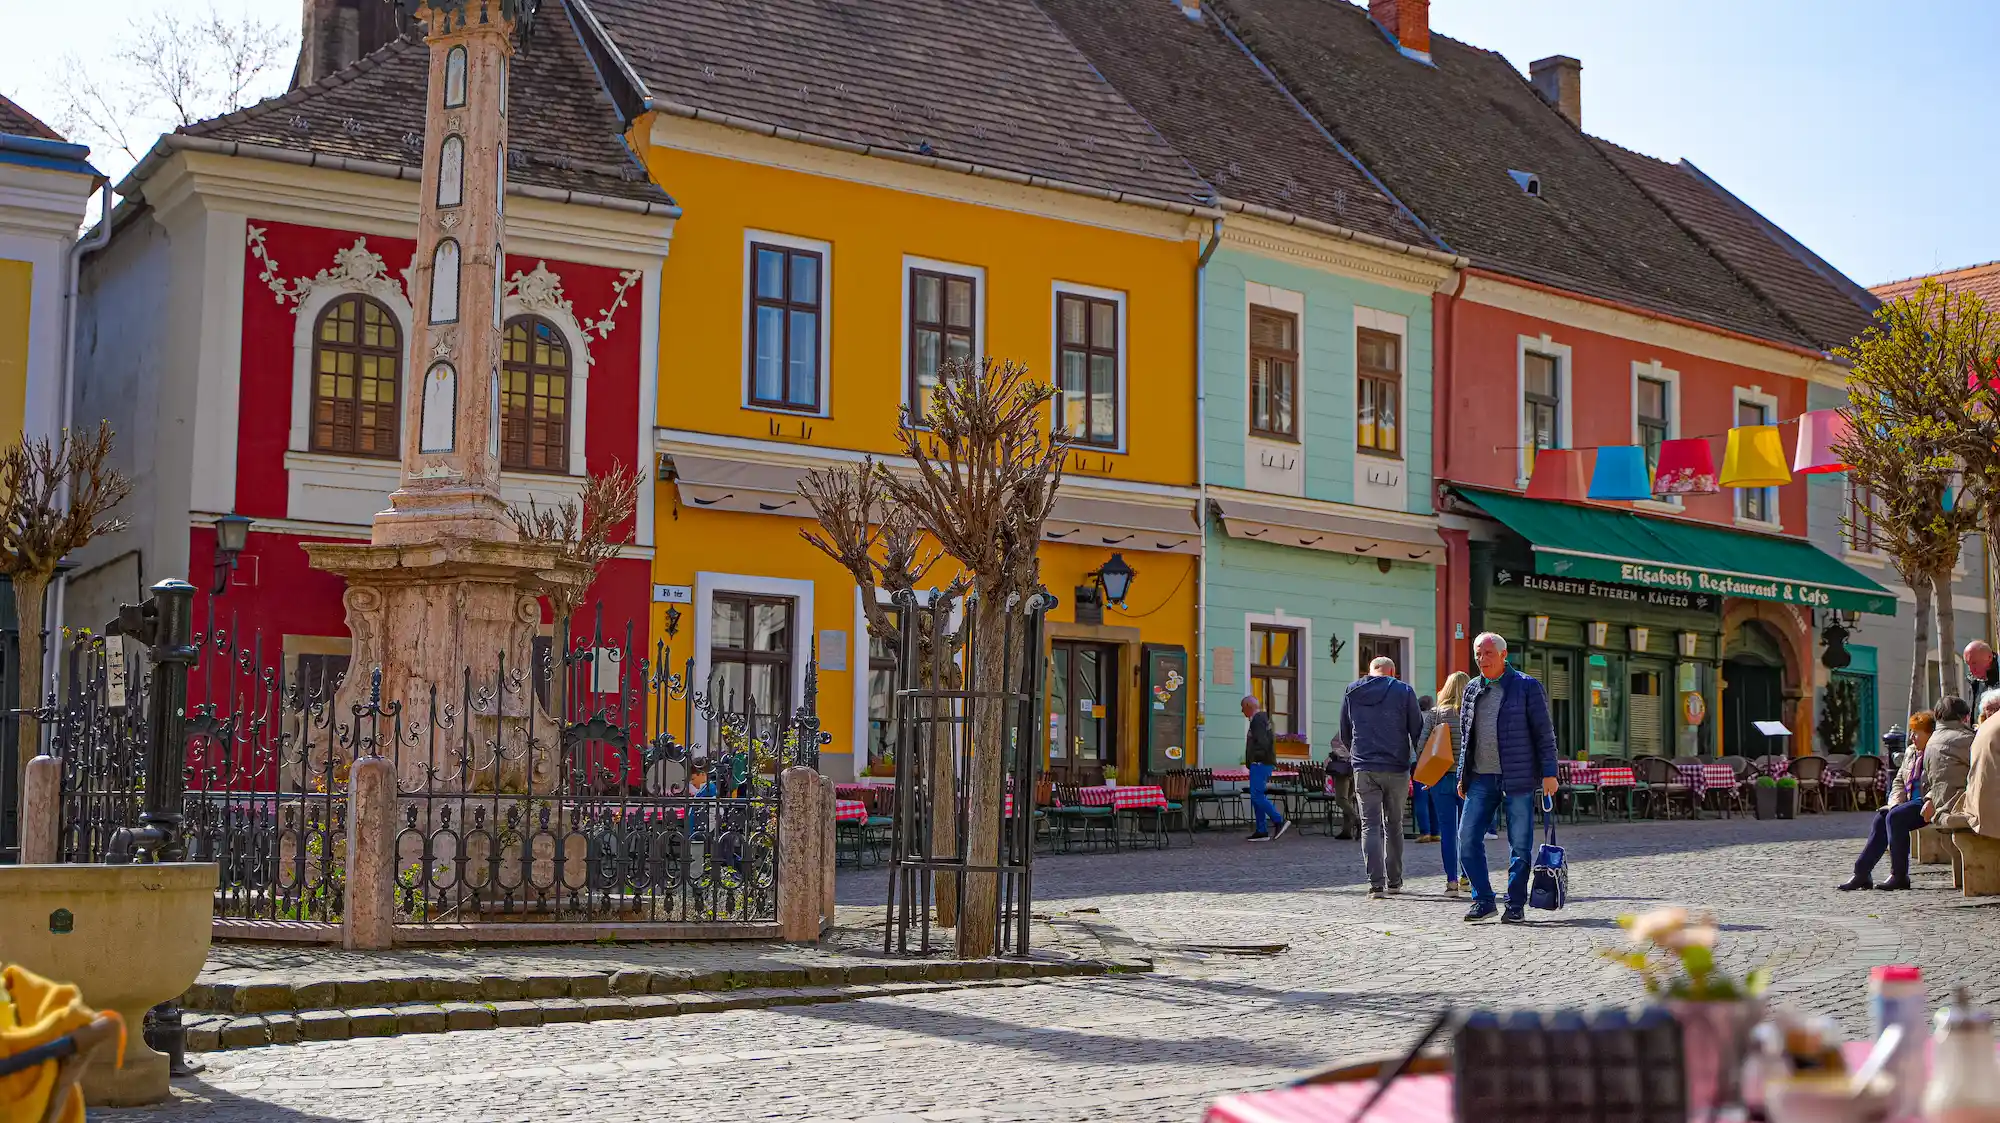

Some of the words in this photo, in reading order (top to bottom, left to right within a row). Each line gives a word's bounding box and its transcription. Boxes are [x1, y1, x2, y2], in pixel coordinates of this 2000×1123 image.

[1523, 575, 1585, 595] ELISABETH
[1589, 582, 1638, 601] ÉTTEREM
[1648, 591, 1689, 607] KÁVÉZÓ
[1621, 564, 1693, 590] Elisabeth
[1699, 573, 1778, 599] Restaurant
[1783, 584, 1794, 600] &
